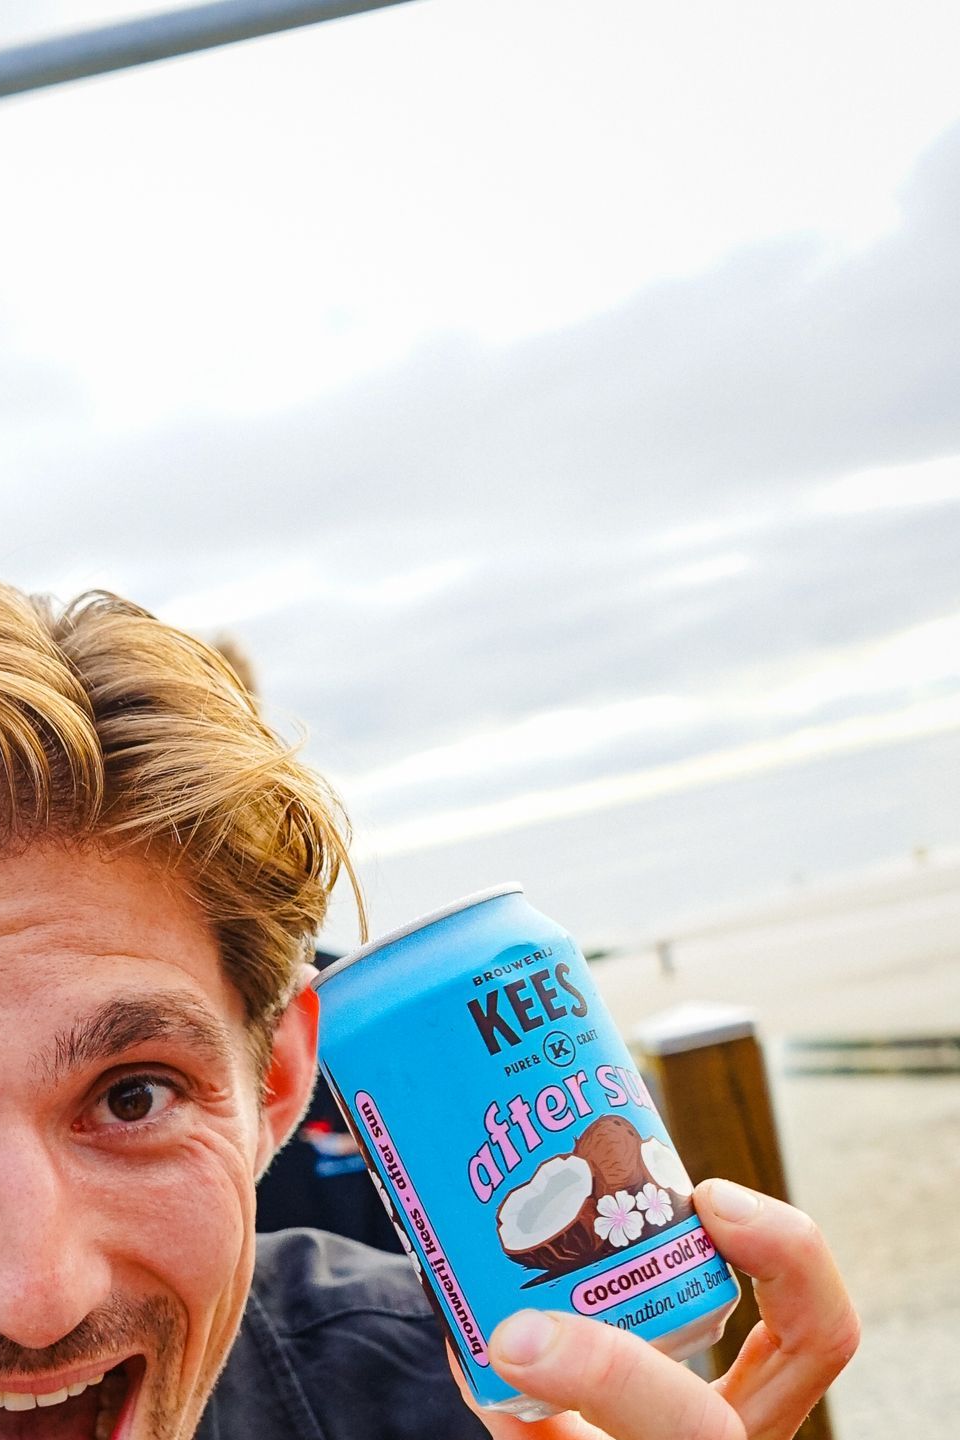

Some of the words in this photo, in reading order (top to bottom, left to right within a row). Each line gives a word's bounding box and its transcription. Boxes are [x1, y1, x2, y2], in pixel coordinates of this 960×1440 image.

[472, 947, 553, 987] BROUWERIJ
[467, 962, 588, 1056] KEES
[576, 1029, 598, 1045] CRAFT
[360, 1101, 383, 1139] sun
[468, 1065, 591, 1204] after
[595, 1064, 656, 1114] su
[376, 1144, 407, 1191] after
[408, 1208, 437, 1256] kees
[582, 1256, 662, 1306] coconut
[663, 1238, 696, 1269] cold
[676, 1276, 705, 1305] with
[431, 1258, 483, 1356] brouwerij
